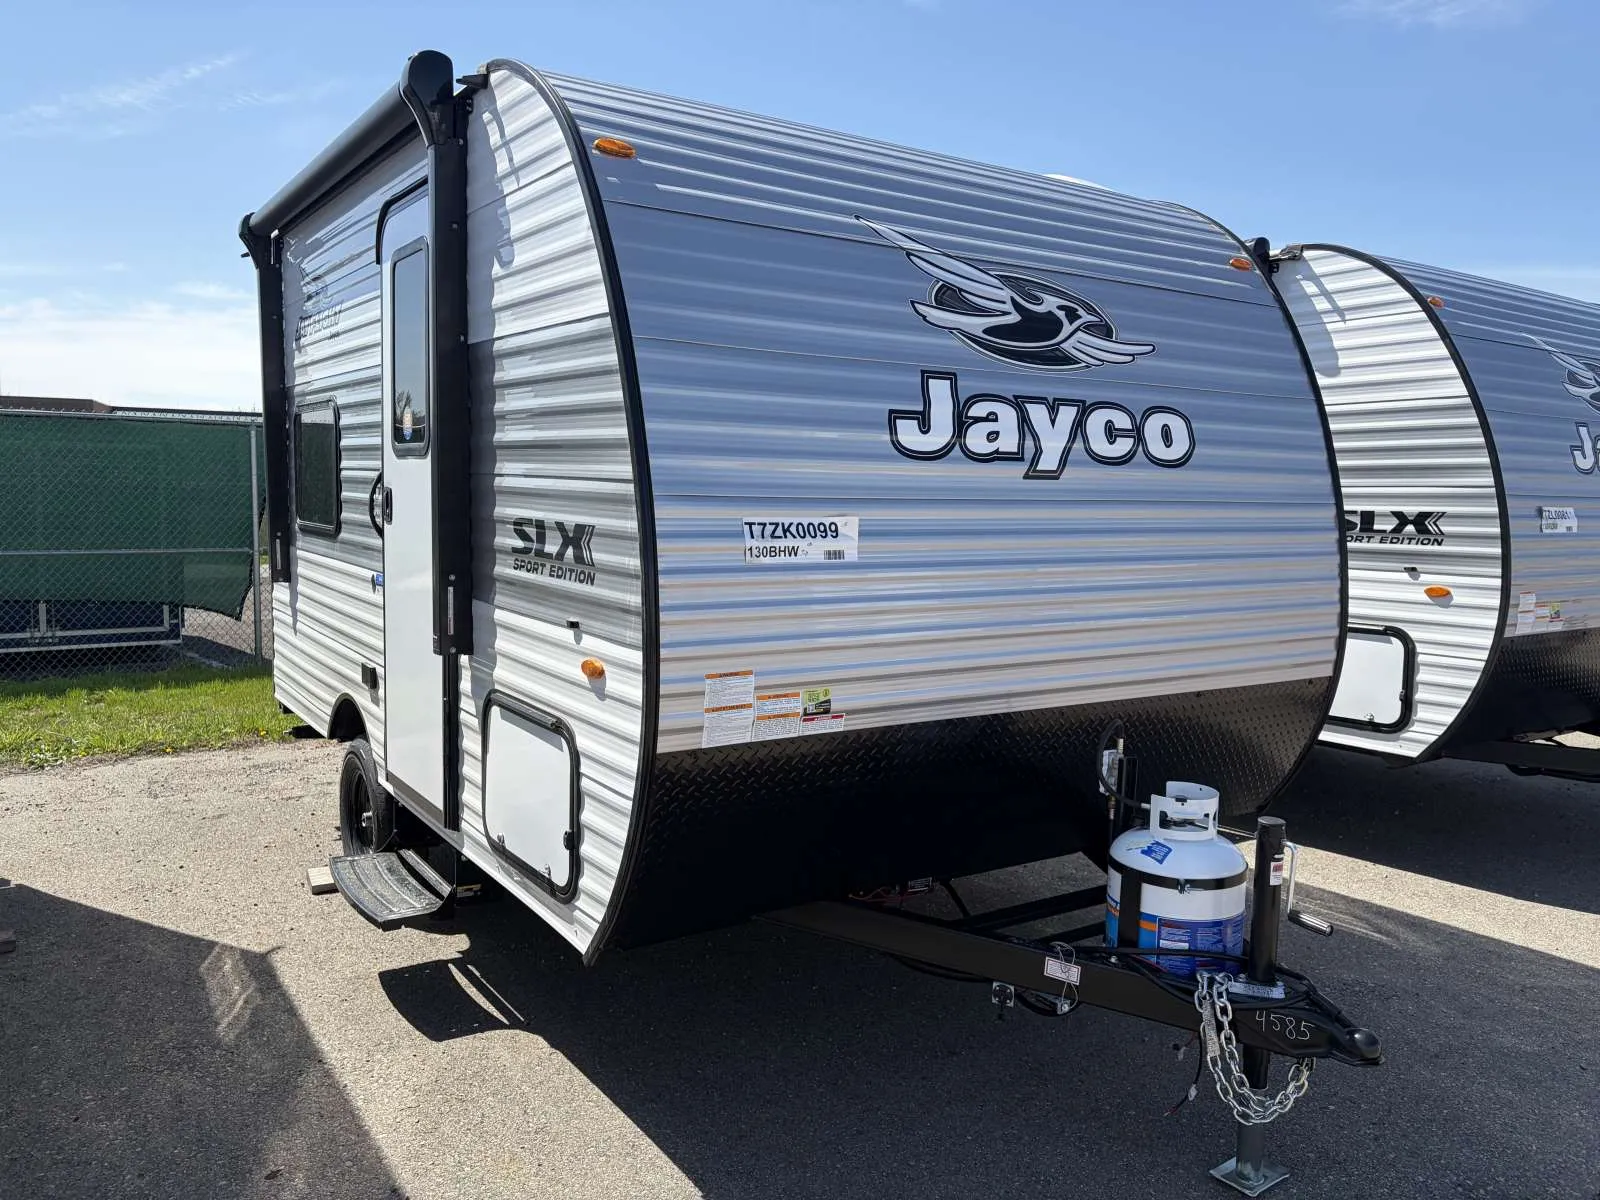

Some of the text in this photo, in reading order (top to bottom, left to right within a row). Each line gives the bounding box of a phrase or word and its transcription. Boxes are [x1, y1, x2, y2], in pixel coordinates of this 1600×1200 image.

[888, 369, 1197, 480] Jayco
[512, 517, 596, 566] SLX
[744, 521, 839, 540] T7ZK0099
[1379, 536, 1445, 546] EDITION
[747, 545, 800, 559] 130BHW
[512, 558, 596, 586] SPORT EDITION
[1255, 1009, 1315, 1041] 4585
